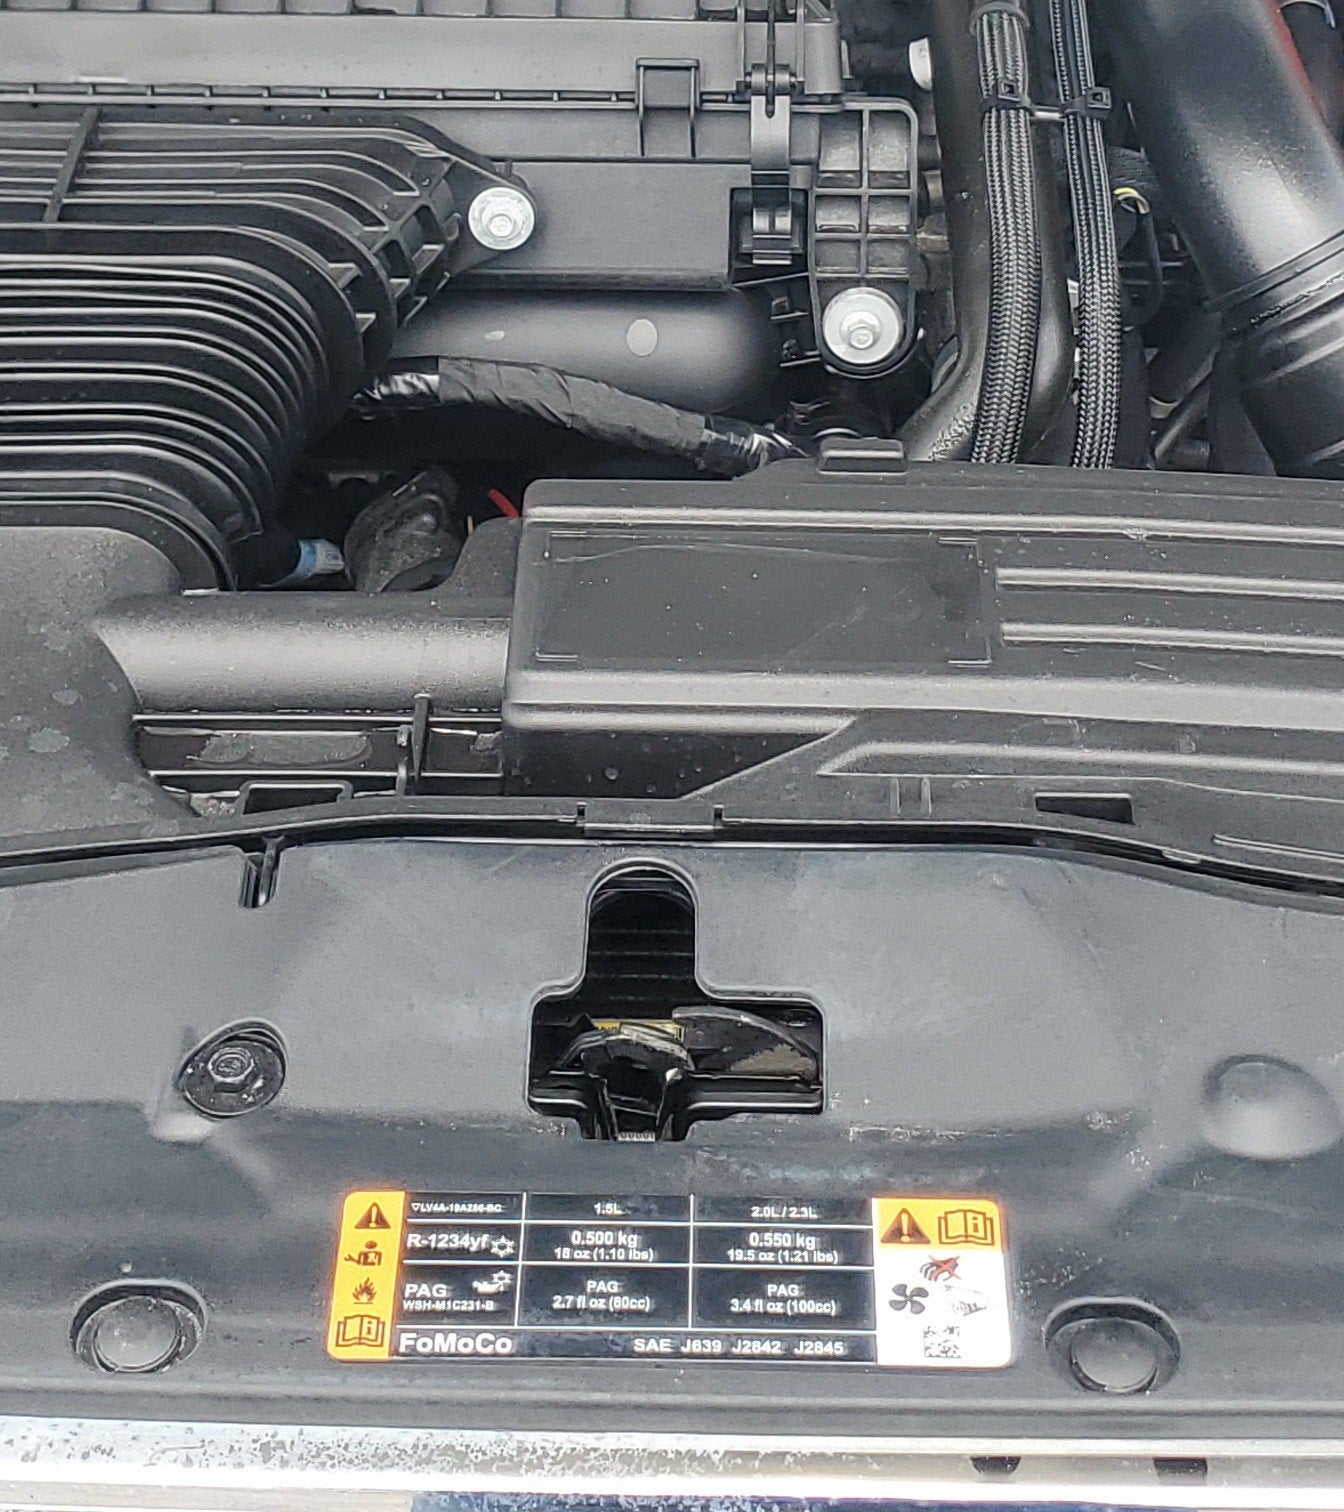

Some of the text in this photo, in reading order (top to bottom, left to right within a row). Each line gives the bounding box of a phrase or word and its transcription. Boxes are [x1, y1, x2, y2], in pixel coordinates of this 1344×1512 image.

[594, 1202, 624, 1215] 1.5L
[751, 1205, 780, 1218] 2.0L
[406, 1233, 490, 1252] R-1234yf
[571, 1230, 639, 1248] 0.500 kg
[749, 1232, 816, 1250] 0.550 kg
[554, 1247, 654, 1262] 18 oz (1.10 lbs)
[727, 1248, 838, 1265] 19.5 oz (1.21 lbs)
[404, 1283, 447, 1297] PAG
[586, 1280, 619, 1293] PAG
[767, 1284, 799, 1297] PAG
[552, 1295, 574, 1309] 2.7
[576, 1295, 586, 1309] fl
[589, 1298, 607, 1309] oz
[730, 1298, 836, 1316] 3.4 fl oz (100cc)
[399, 1332, 513, 1354] FoMoCo
[633, 1338, 844, 1355] SAE J639 J2842 J2845
